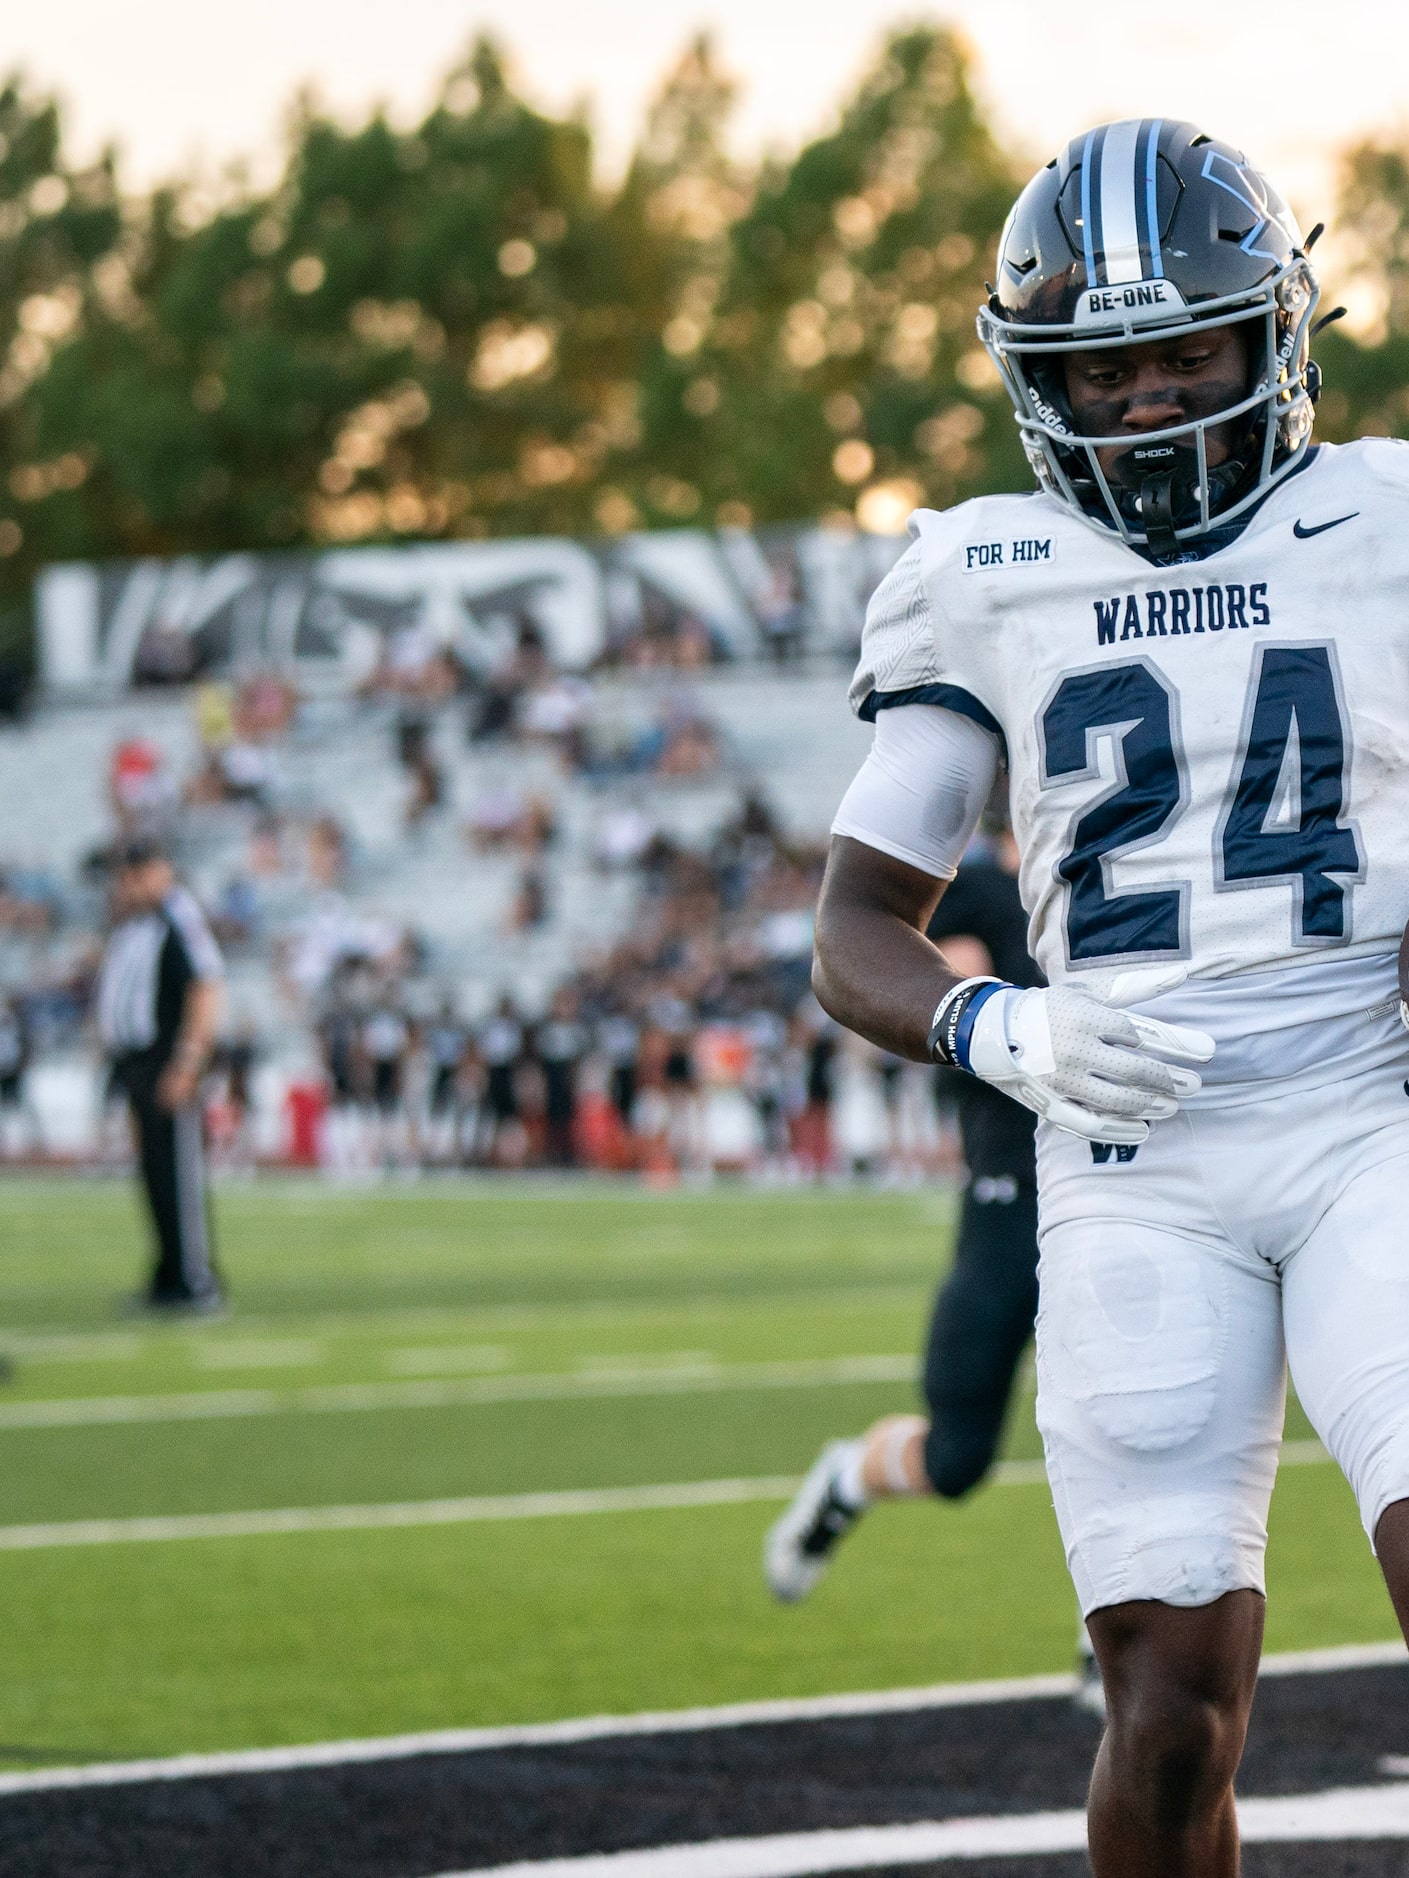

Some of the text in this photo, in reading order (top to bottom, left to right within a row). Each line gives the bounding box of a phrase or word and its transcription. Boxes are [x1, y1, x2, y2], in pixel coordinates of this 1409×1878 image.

[1088, 283, 1169, 313] BE-ONE
[1134, 446, 1175, 460] SHOCK
[966, 538, 1052, 568] FOR HIM
[1093, 582, 1271, 646] WARRIORS
[1034, 637, 1368, 972] 24
[949, 996, 964, 1024] CLUB
[947, 1025, 957, 1050] MPH
